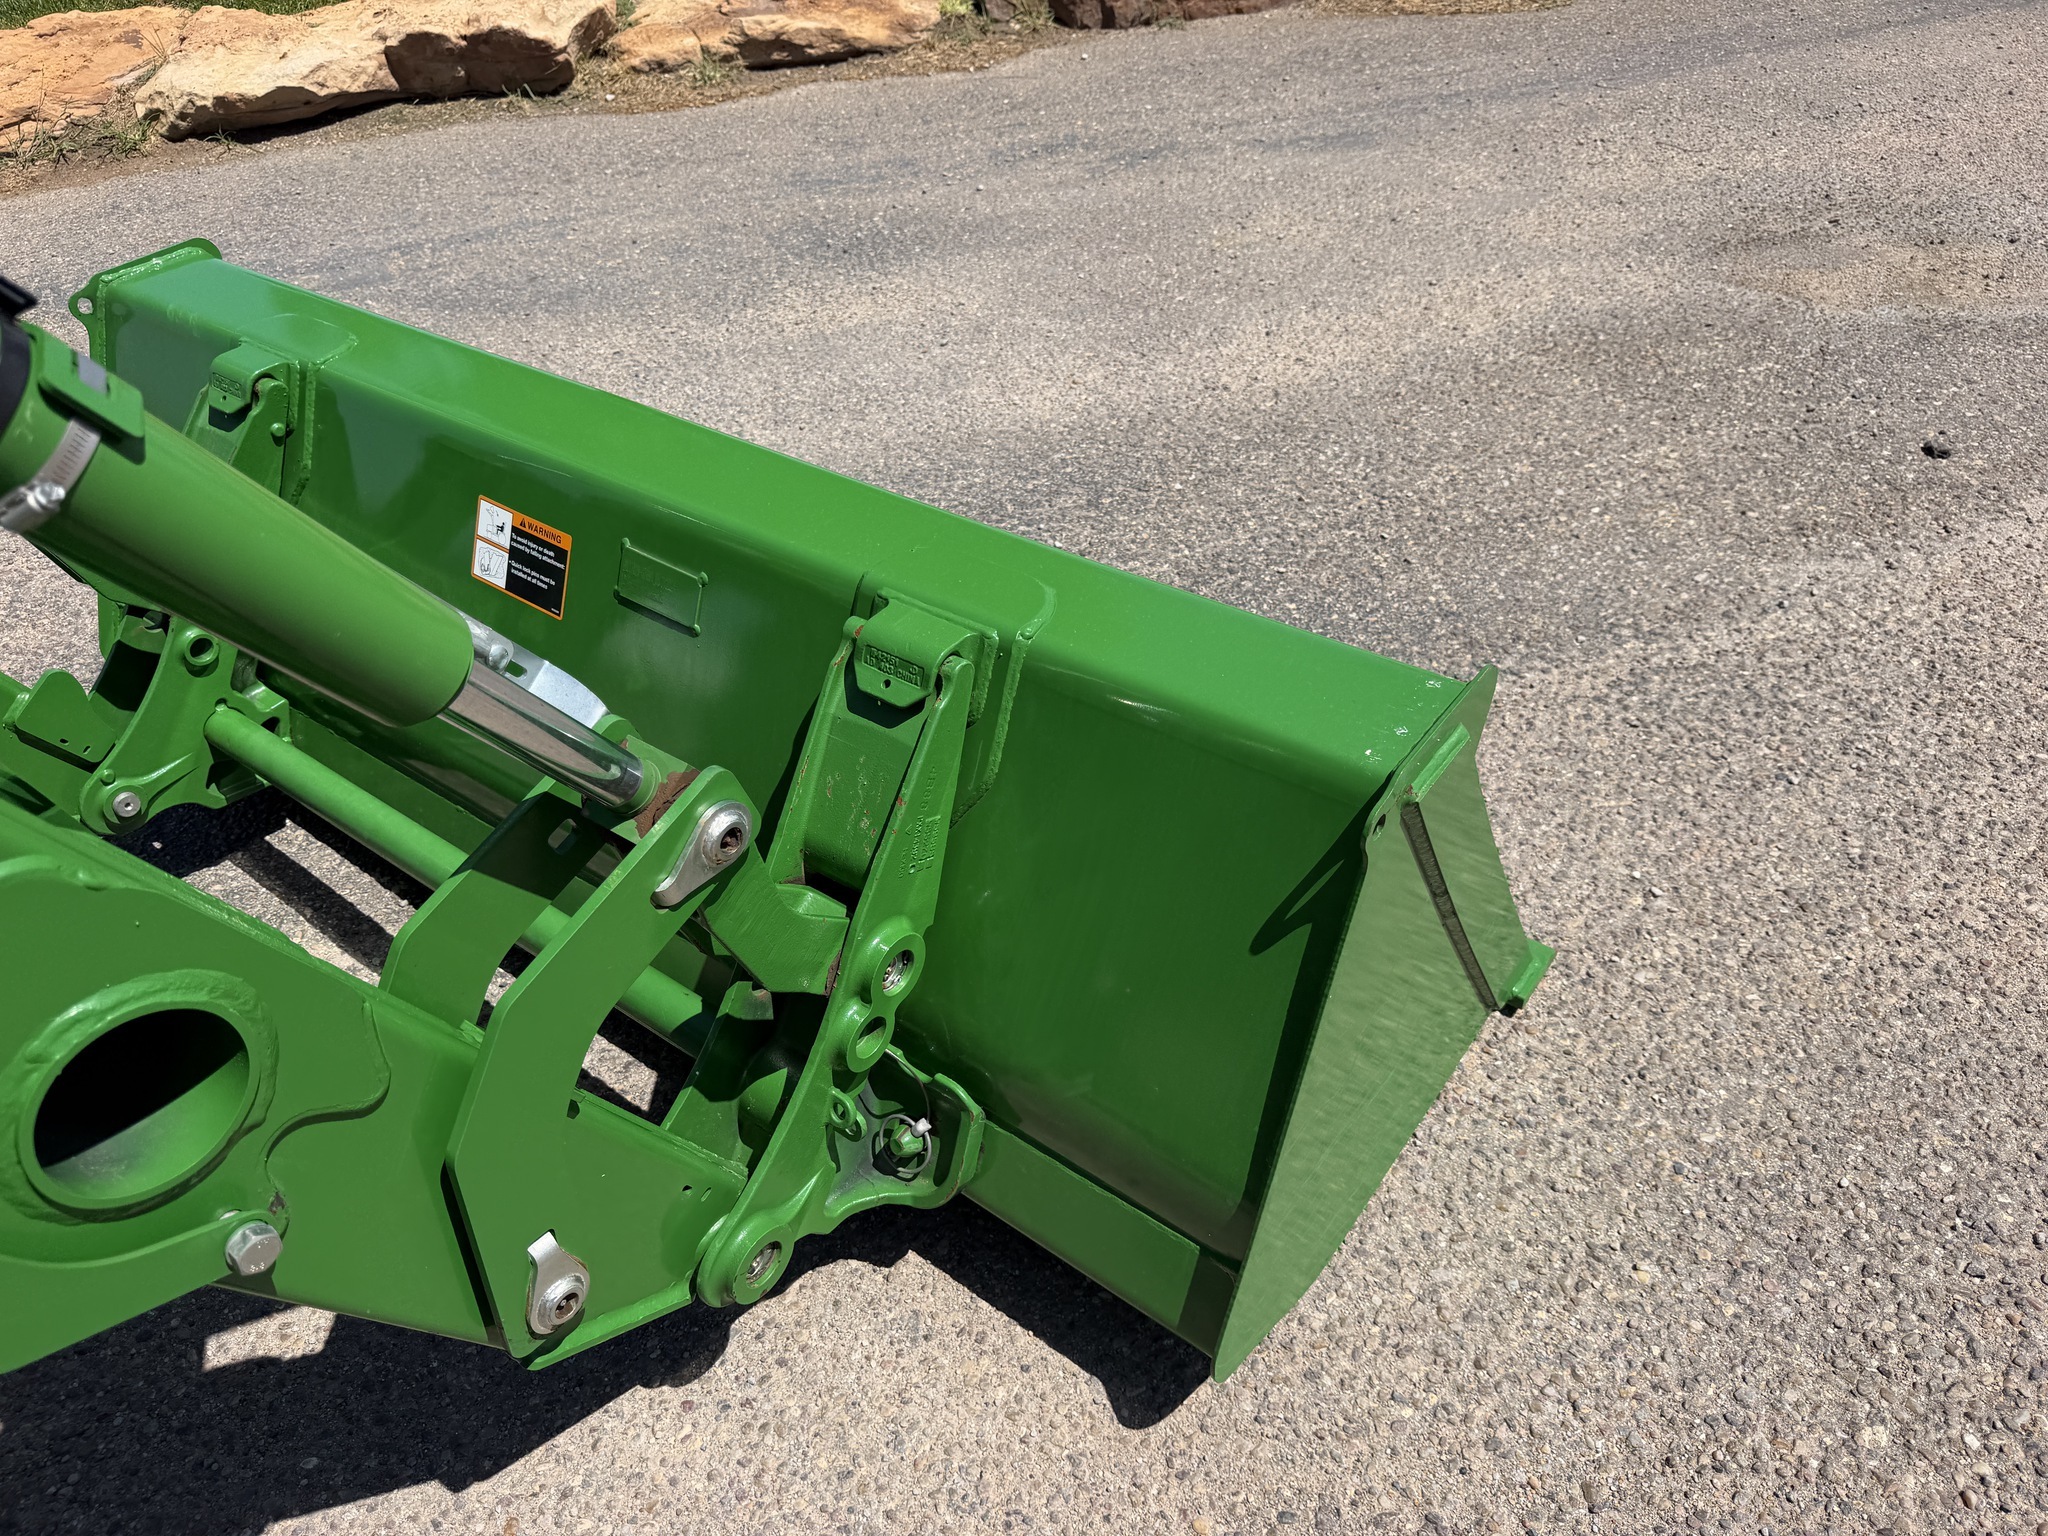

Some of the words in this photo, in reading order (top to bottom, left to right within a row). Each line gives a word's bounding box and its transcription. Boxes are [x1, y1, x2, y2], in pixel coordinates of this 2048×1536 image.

[527, 521, 562, 543] WARNING
[510, 541, 525, 551] caused
[530, 549, 543, 560] falling
[511, 532, 517, 540] To
[516, 536, 528, 545] avoid
[527, 540, 539, 551] injury
[543, 548, 555, 558] death
[511, 560, 523, 570] Quick
[522, 566, 531, 574] lock
[530, 570, 540, 578] pins
[539, 575, 550, 583] must
[511, 567, 527, 580] installed
[536, 580, 548, 590] times
